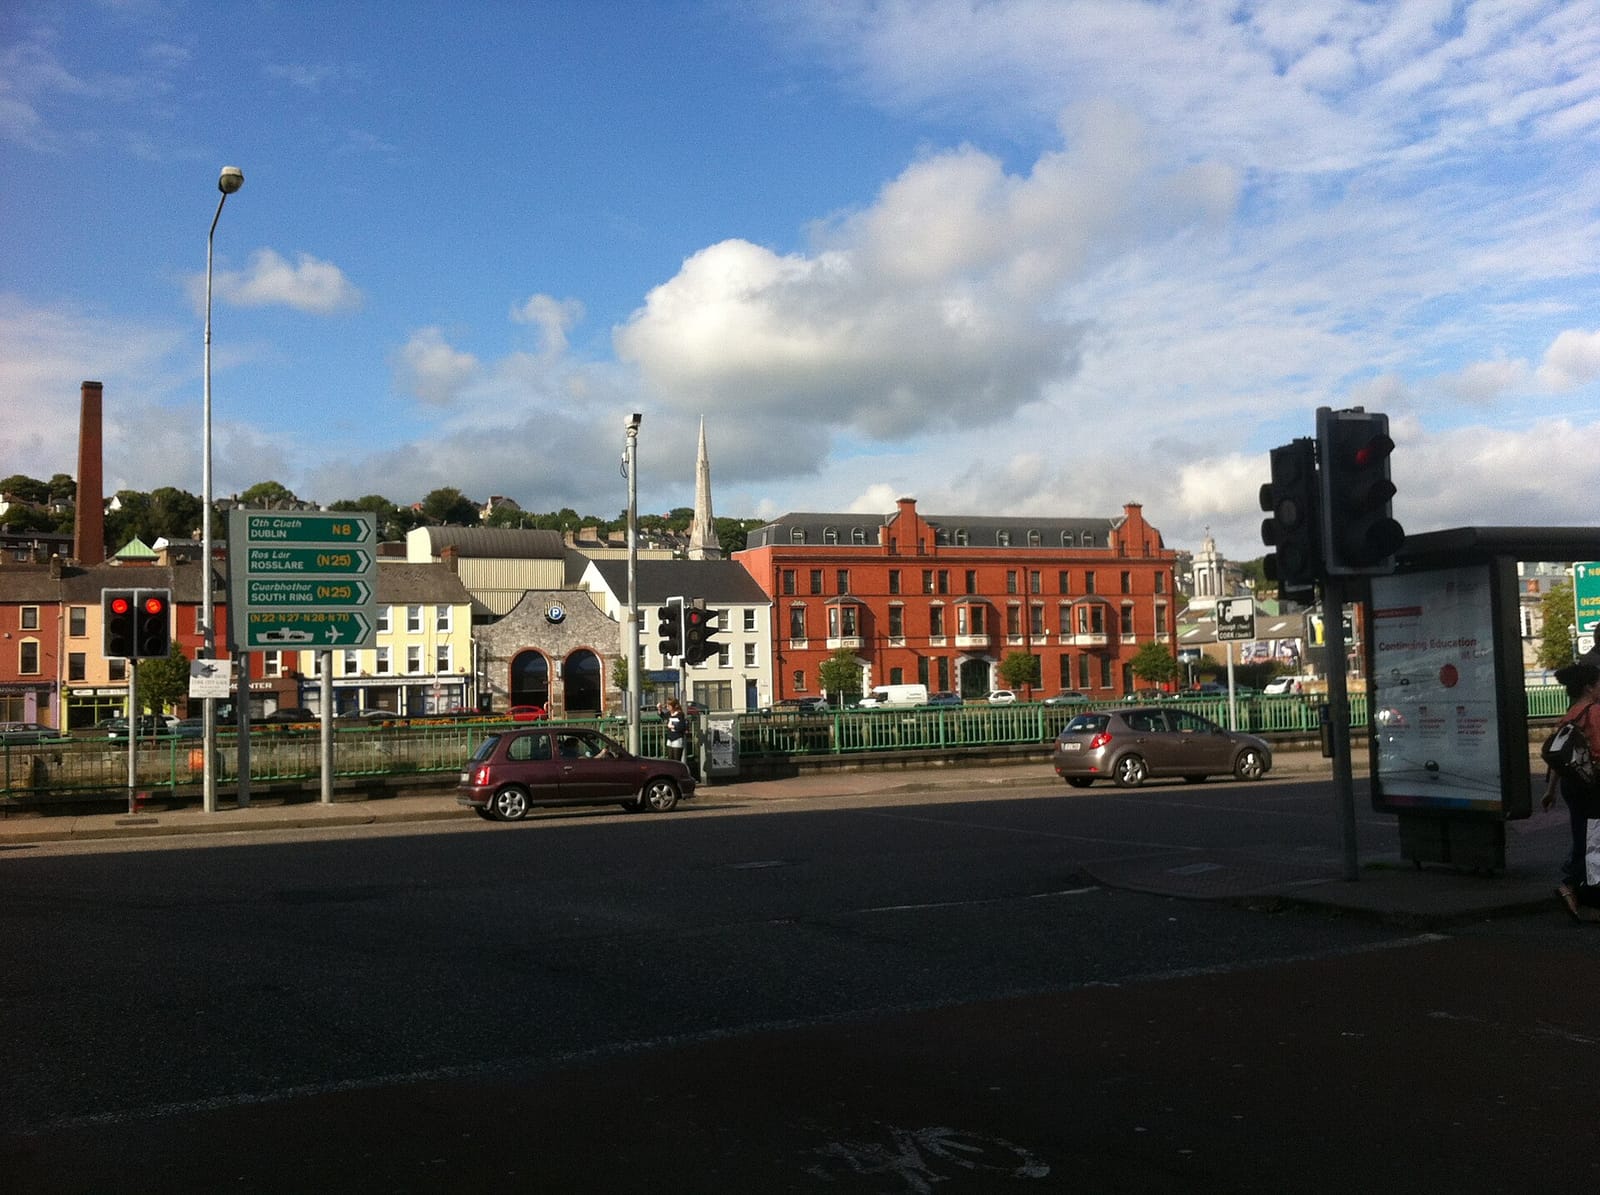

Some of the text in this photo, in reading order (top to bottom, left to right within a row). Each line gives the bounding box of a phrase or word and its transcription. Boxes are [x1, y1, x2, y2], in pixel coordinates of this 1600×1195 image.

[250, 529, 287, 538] DUBLIN
[251, 550, 269, 559] Ros
[250, 561, 304, 570] ROSSLARE
[251, 593, 314, 602] SOUTH RING
[552, 608, 560, 617] P
[1379, 637, 1477, 652] Continuing Education
